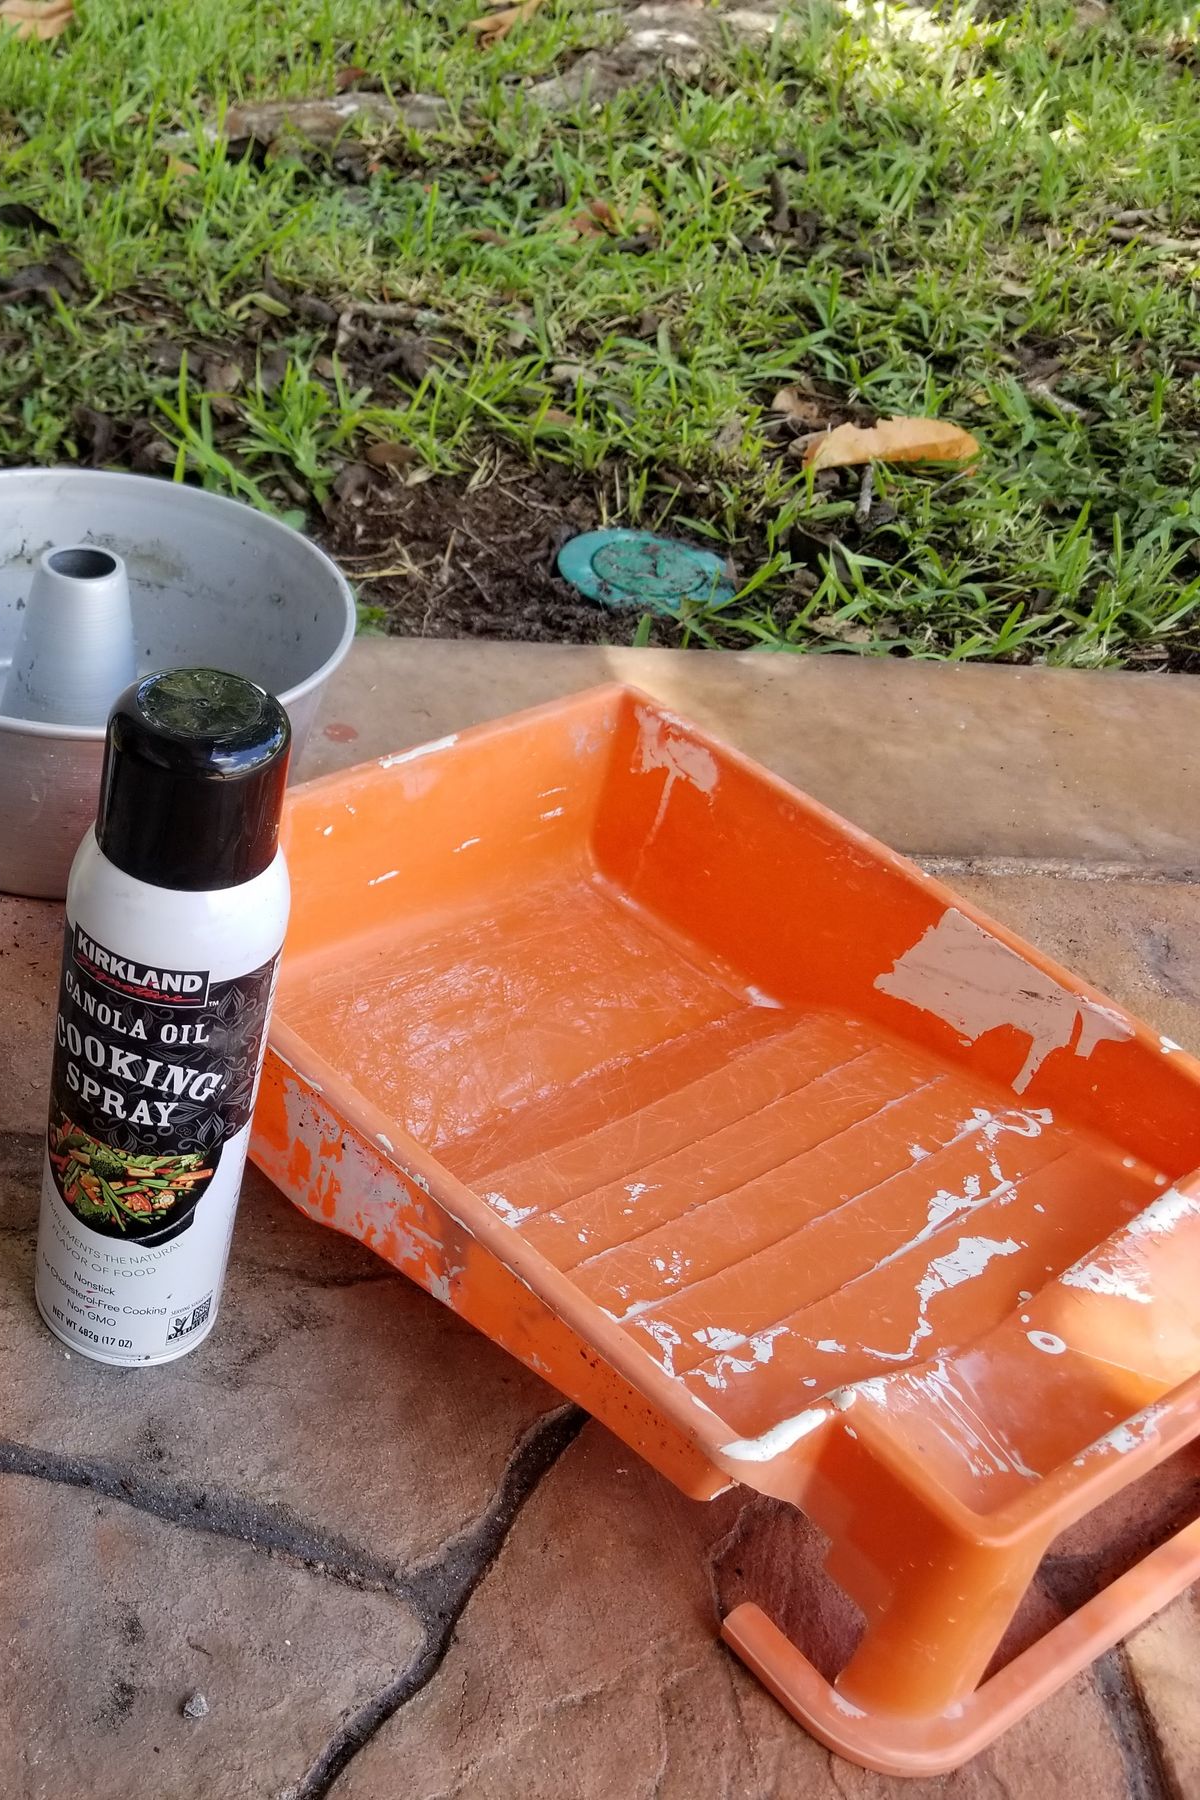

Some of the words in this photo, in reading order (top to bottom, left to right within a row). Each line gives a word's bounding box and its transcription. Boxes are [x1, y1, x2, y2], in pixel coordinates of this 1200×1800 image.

[76, 930, 203, 993] KIRKLAND
[65, 969, 148, 1041] CANOLA
[160, 1023, 210, 1045] OIL
[57, 1012, 224, 1102] COOKING
[66, 1061, 179, 1127] SPRAY
[91, 1262, 110, 1275] OF
[113, 1266, 156, 1278] FOOD
[105, 1252, 127, 1265] THE
[129, 1241, 185, 1265] NATURAL
[50, 1266, 120, 1313] Cholesterol-Free
[122, 1305, 167, 1317] Cooking
[73, 1271, 116, 1297] Nonstick
[52, 1307, 65, 1322] NET
[65, 1317, 78, 1331] WT
[78, 1326, 99, 1343] 482g
[101, 1334, 116, 1347] (17
[118, 1338, 133, 1349] OZ)
[66, 1298, 85, 1316] Non
[87, 1311, 117, 1327] GMO
